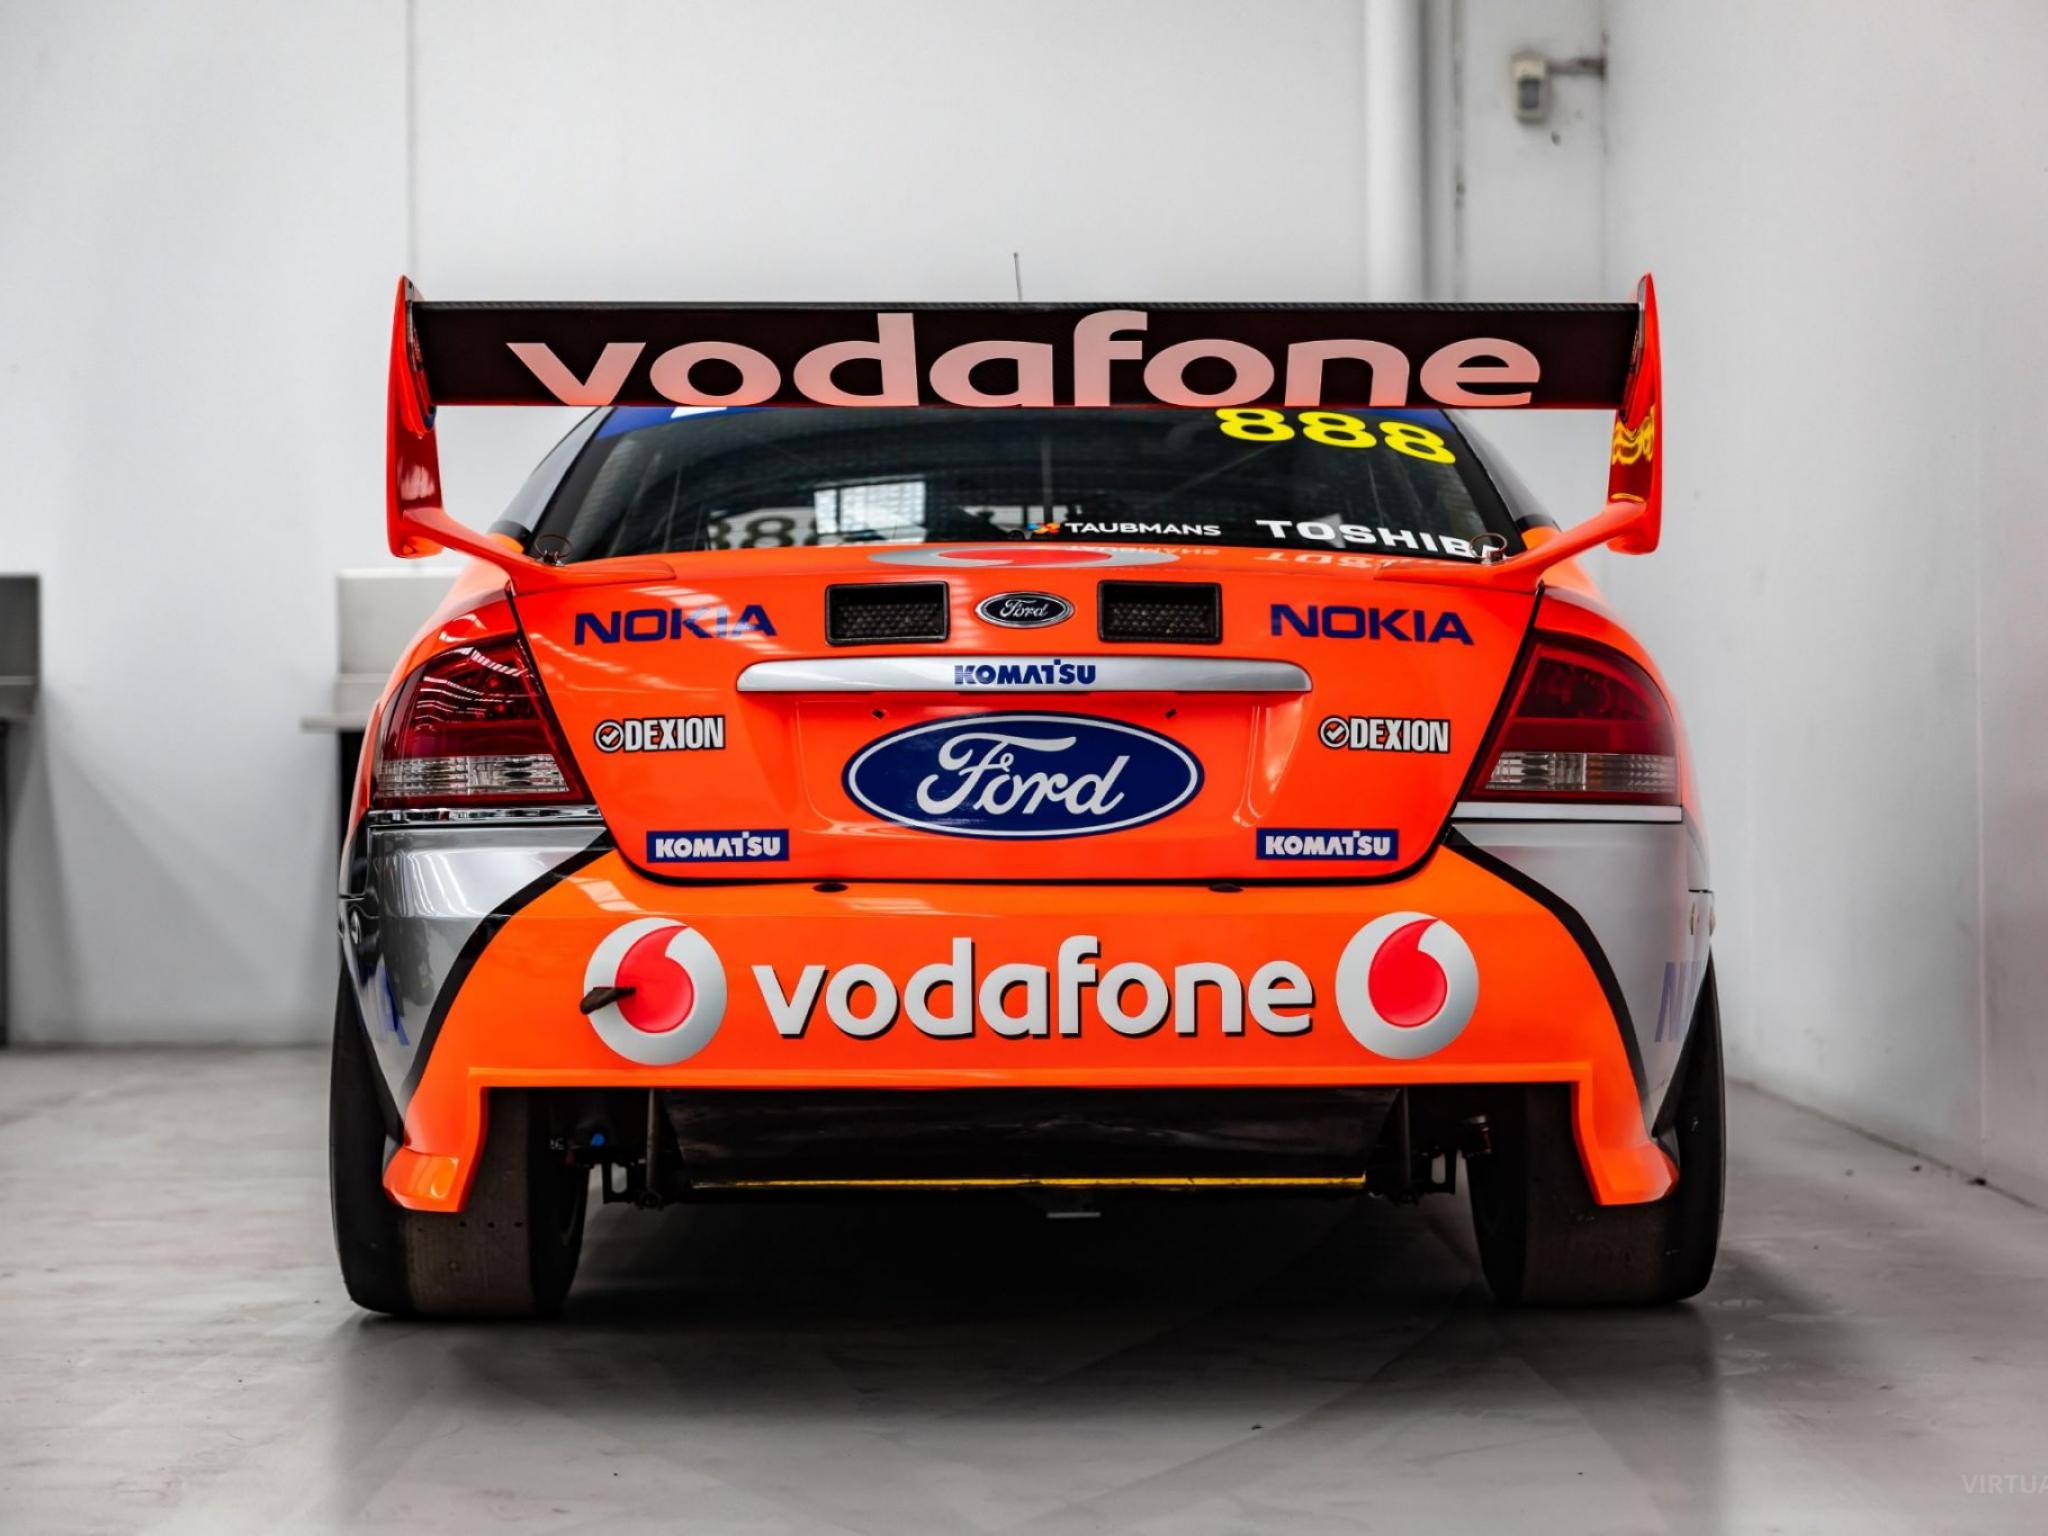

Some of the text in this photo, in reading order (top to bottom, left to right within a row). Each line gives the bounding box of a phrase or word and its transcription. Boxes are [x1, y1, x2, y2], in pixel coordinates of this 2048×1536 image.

[506, 310, 1541, 407] vodafone
[1216, 407, 1456, 464] 888
[1065, 522, 1222, 536] TAUBMANS
[575, 604, 777, 645] NOKIA
[1000, 599, 1049, 618] Ford
[1271, 604, 1474, 645] NOKIA
[954, 659, 1096, 684] KOMATSU
[624, 717, 724, 751] DEXION
[1350, 718, 1449, 752] DEXION
[916, 732, 1131, 815] Ford
[655, 831, 781, 858] KOMATSU
[1265, 830, 1391, 856] KOMATSU
[751, 934, 1313, 1036] vodafone
